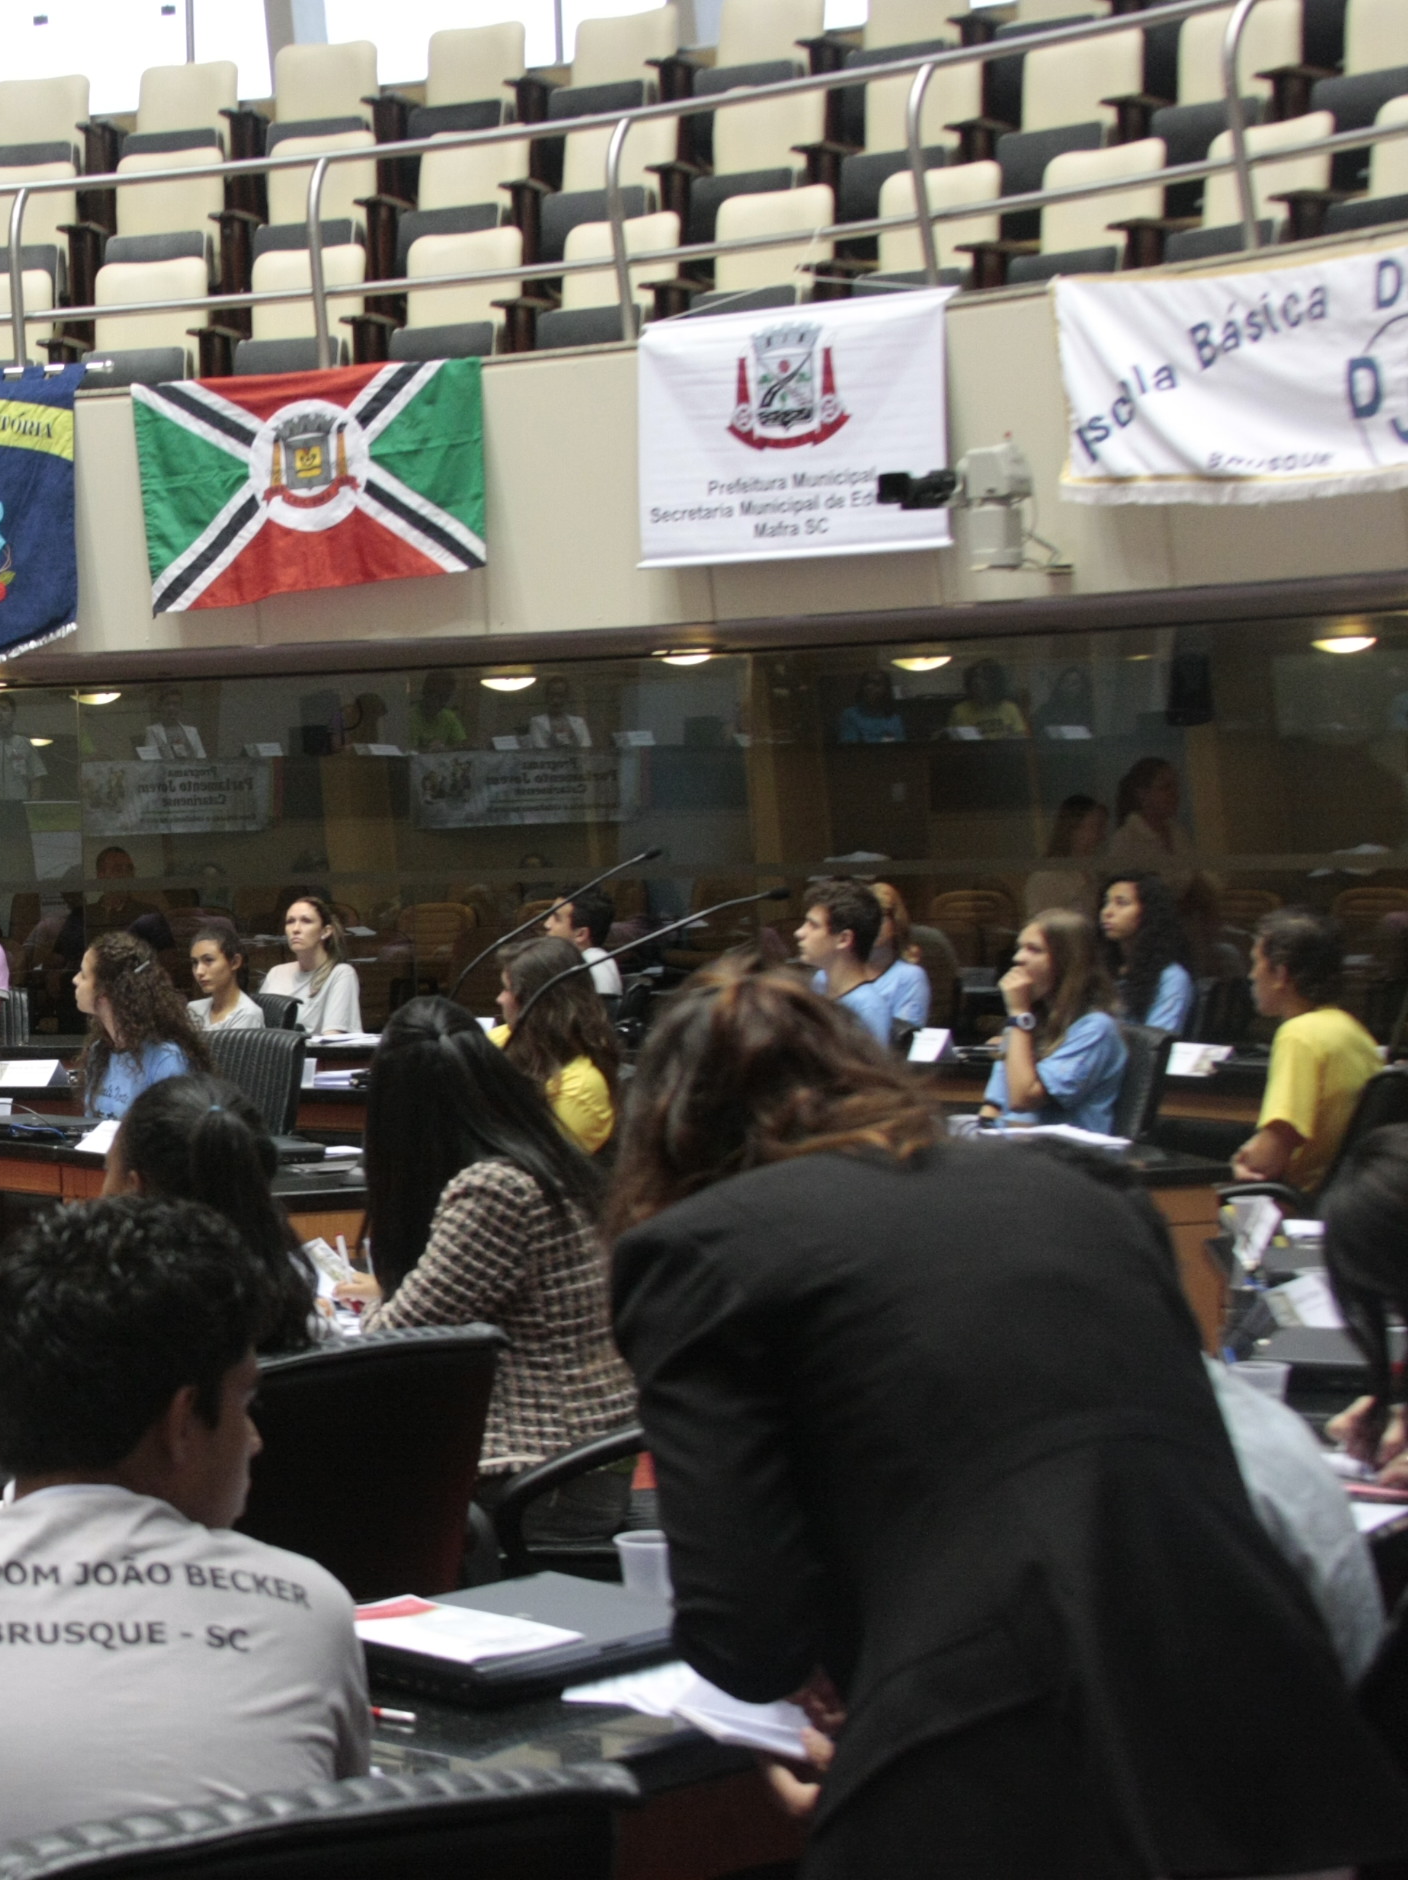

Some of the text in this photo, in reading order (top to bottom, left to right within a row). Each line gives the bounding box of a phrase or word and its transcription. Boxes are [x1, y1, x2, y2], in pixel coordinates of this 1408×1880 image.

[1188, 284, 1328, 371] Básica
[707, 466, 877, 495] Prefeitura Municipal
[650, 504, 734, 524] Secretaria
[740, 494, 820, 516] Municipal
[825, 493, 844, 510] de
[753, 517, 830, 538] Mafra SC
[74, 1556, 172, 1587] JOÃO
[184, 1562, 313, 1608] BECKER
[205, 1625, 250, 1653] SC
